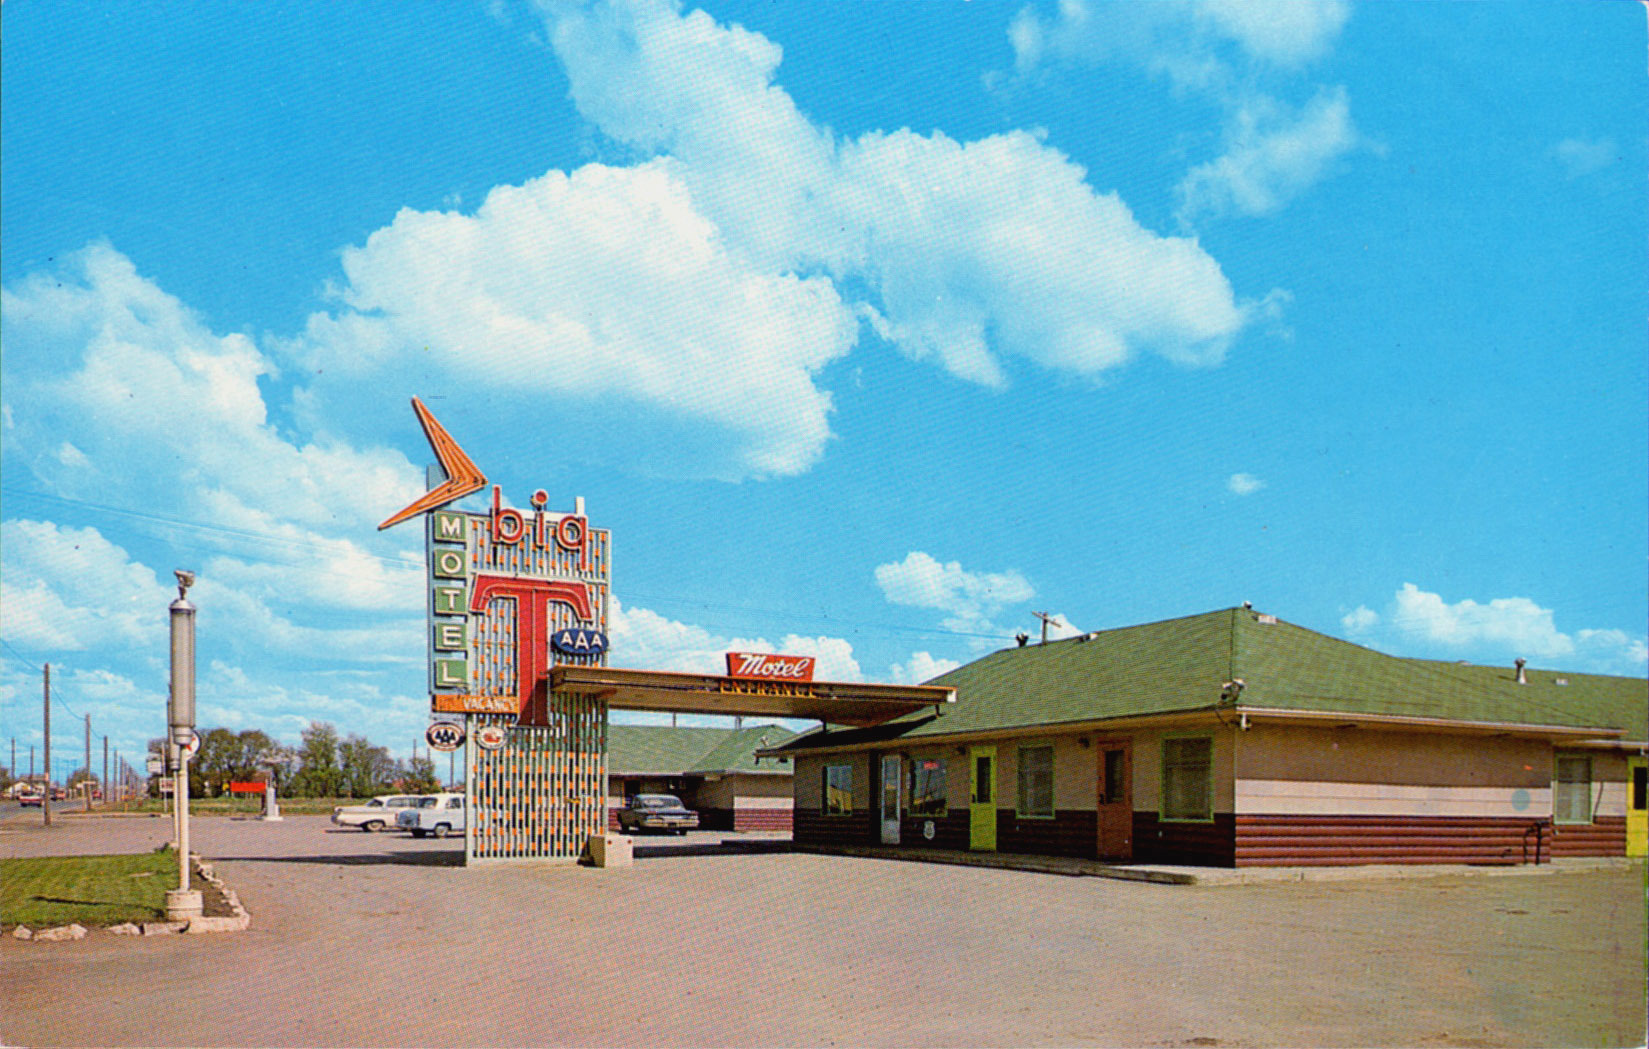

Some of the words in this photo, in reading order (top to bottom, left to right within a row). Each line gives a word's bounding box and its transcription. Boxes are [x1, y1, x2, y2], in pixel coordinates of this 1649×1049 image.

[491, 484, 588, 571] big
[439, 514, 465, 684] MOTEL
[469, 572, 594, 728] T
[559, 629, 604, 651] AAA
[736, 654, 810, 678] Motel
[719, 680, 818, 699] ENTRANCE
[463, 697, 516, 711] VACANCY
[434, 729, 457, 744] AAA
